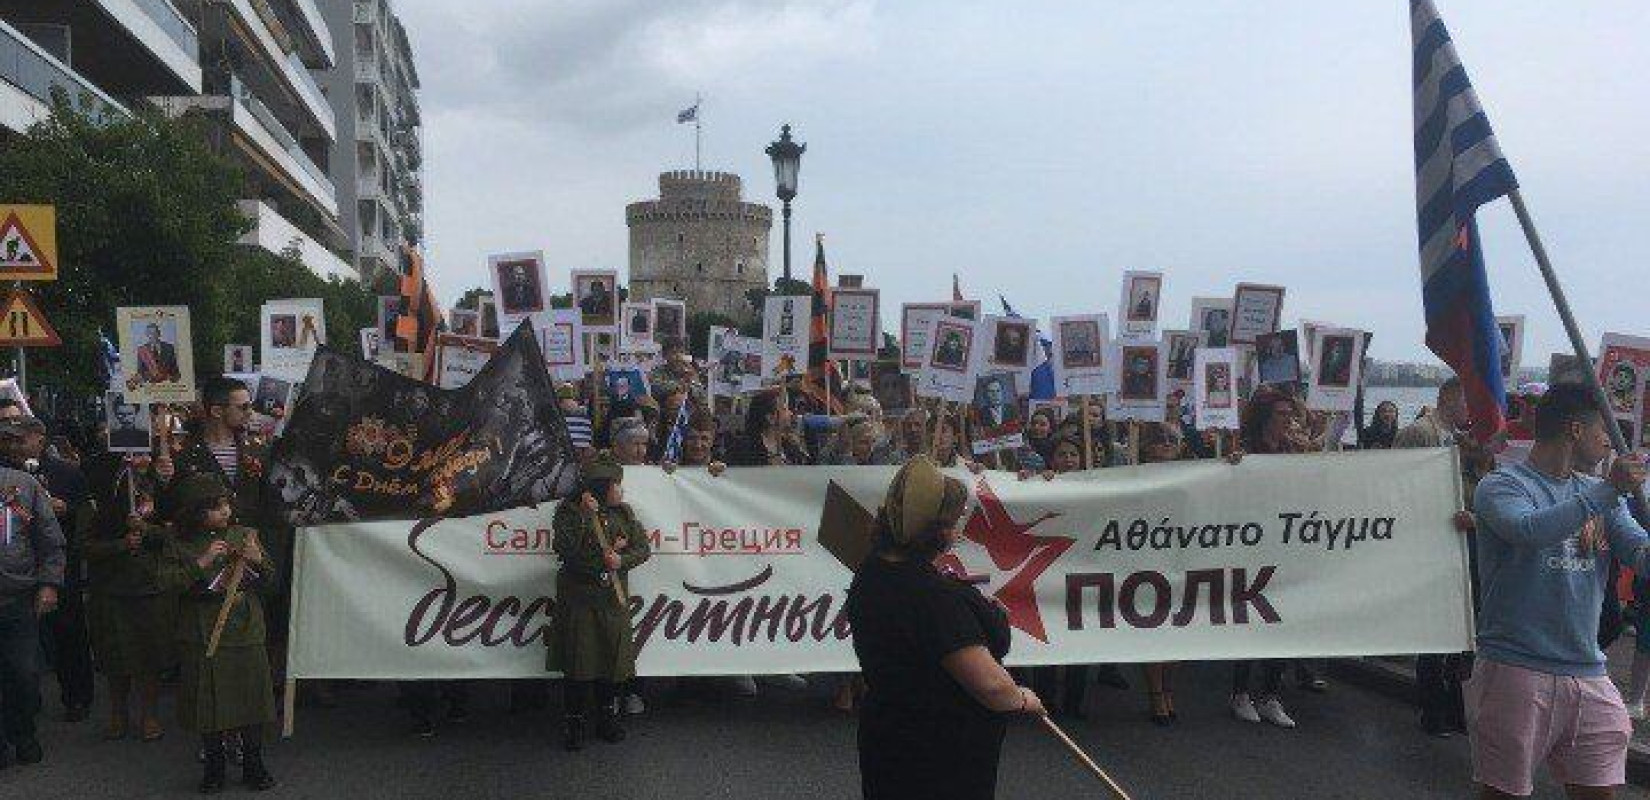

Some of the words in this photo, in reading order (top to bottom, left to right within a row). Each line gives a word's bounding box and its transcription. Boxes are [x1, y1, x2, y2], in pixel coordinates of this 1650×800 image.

[485, 520, 803, 553] Сали-Греция
[1095, 517, 1264, 551] Αθάνατο
[1278, 511, 1396, 551] Τάγμα
[1065, 565, 1282, 631] ПОЛК
